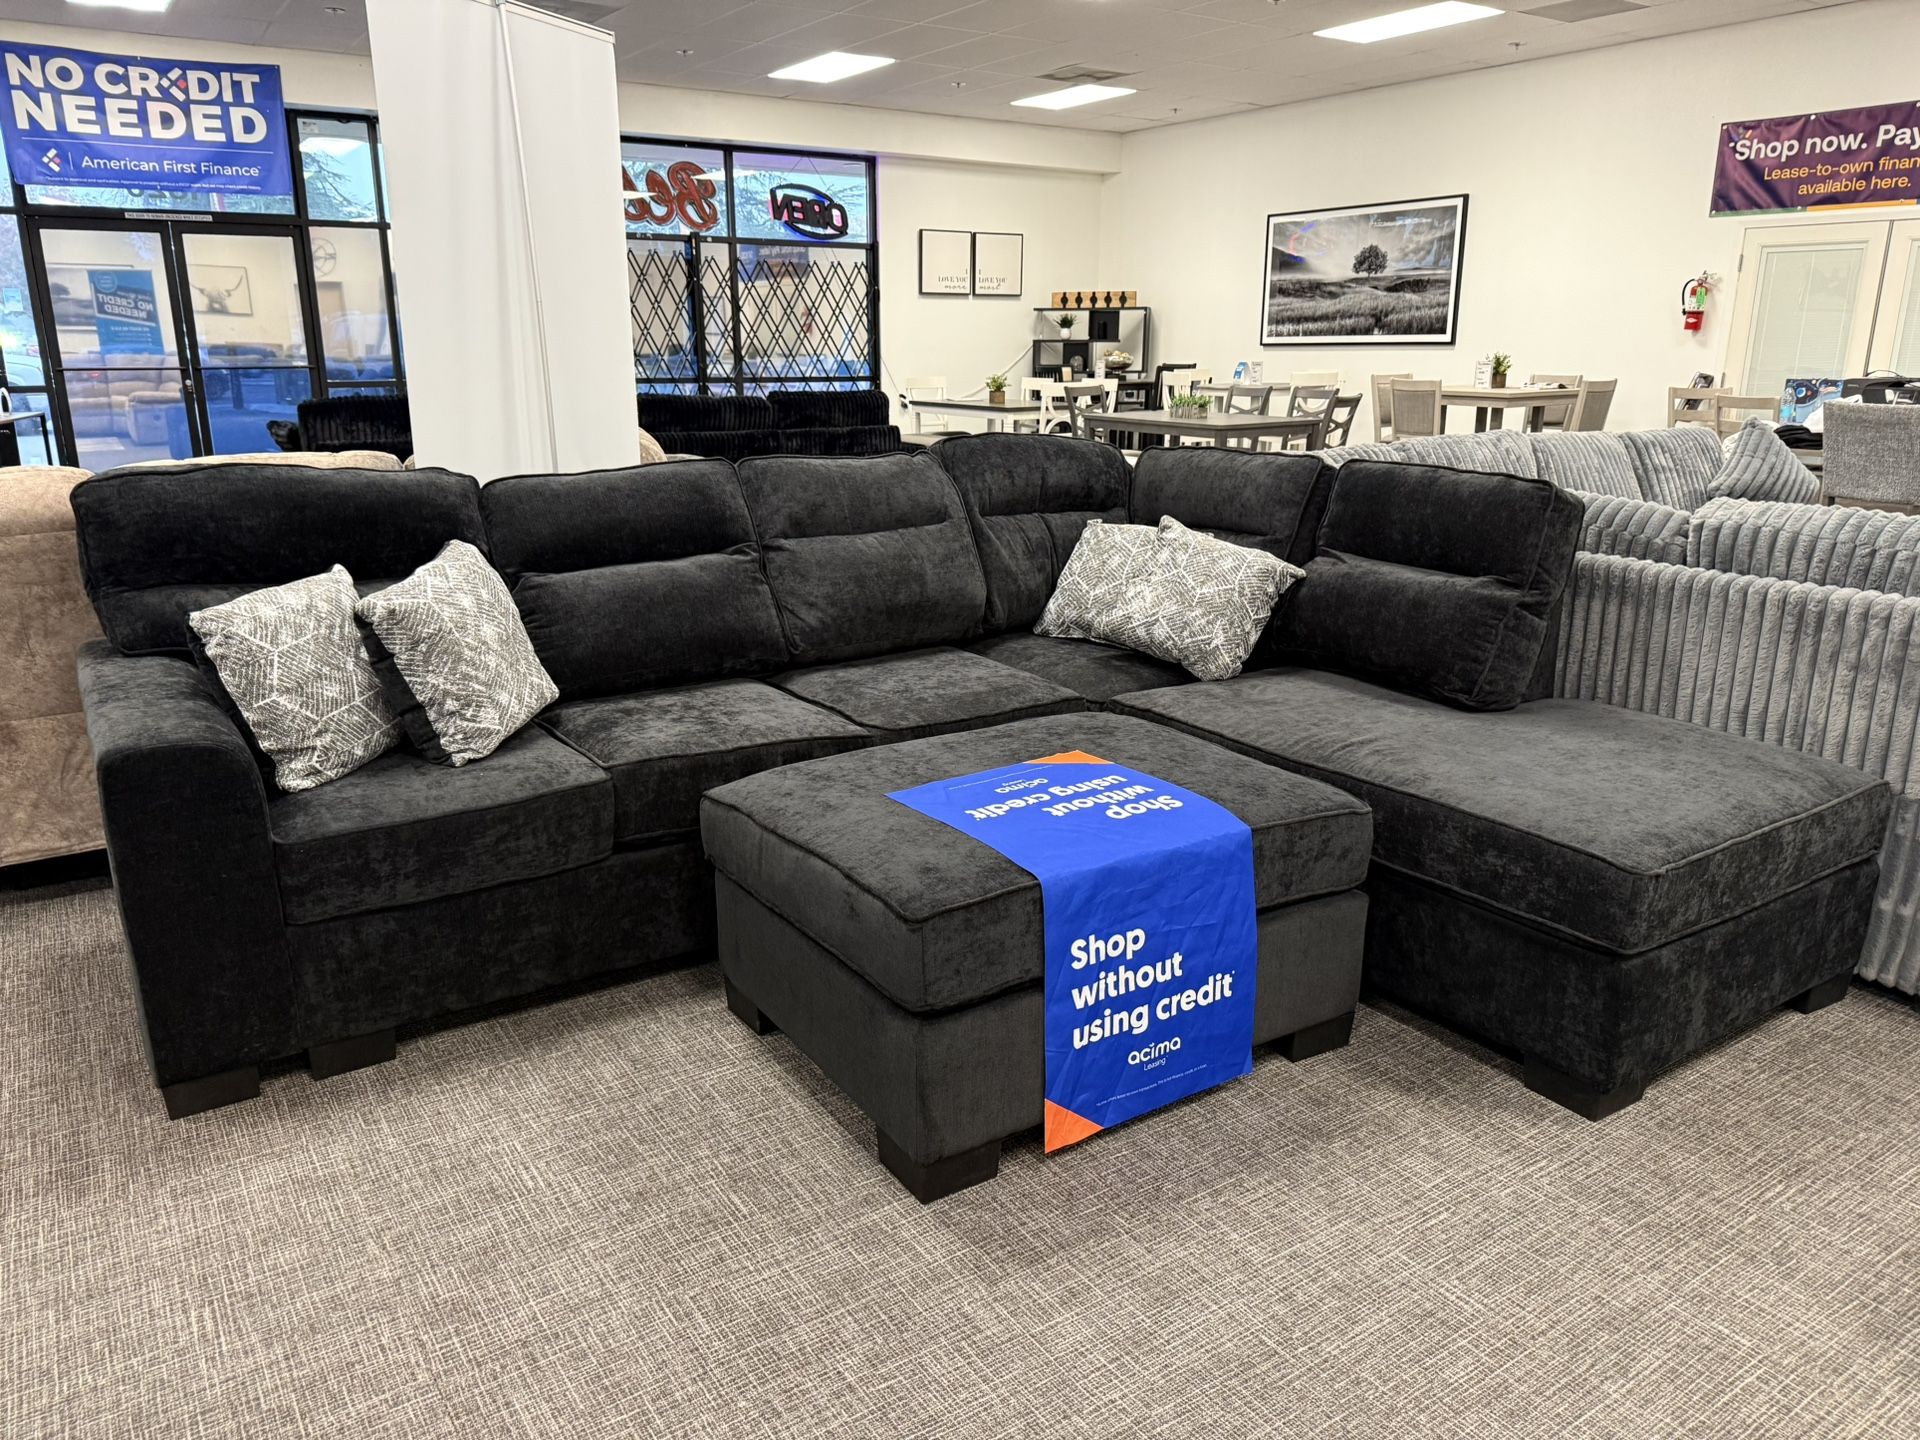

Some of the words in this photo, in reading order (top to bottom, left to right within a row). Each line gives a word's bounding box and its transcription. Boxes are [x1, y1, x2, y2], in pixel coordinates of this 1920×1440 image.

[5, 53, 84, 92] NO
[94, 63, 260, 105] CRDIT
[11, 90, 269, 144] NEEDED
[1734, 138, 1799, 163] Shop
[1804, 133, 1868, 155] now.
[1875, 124, 1920, 150] Pay
[81, 155, 160, 173] American
[163, 159, 197, 174] First
[201, 162, 262, 177] Finance
[1764, 160, 1873, 180] Lease-to-own
[1797, 178, 1866, 196] available
[1870, 175, 1912, 190] here.
[978, 276, 995, 284] LOVE
[1041, 785, 1155, 816] without
[1048, 775, 1128, 800] using
[1105, 795, 1184, 820] Shop
[1070, 928, 1146, 970] Shop
[1071, 951, 1183, 1010] without
[1072, 1003, 1149, 1050] using
[1127, 1036, 1181, 1066] acima
[1143, 1056, 1169, 1071] Leasing
